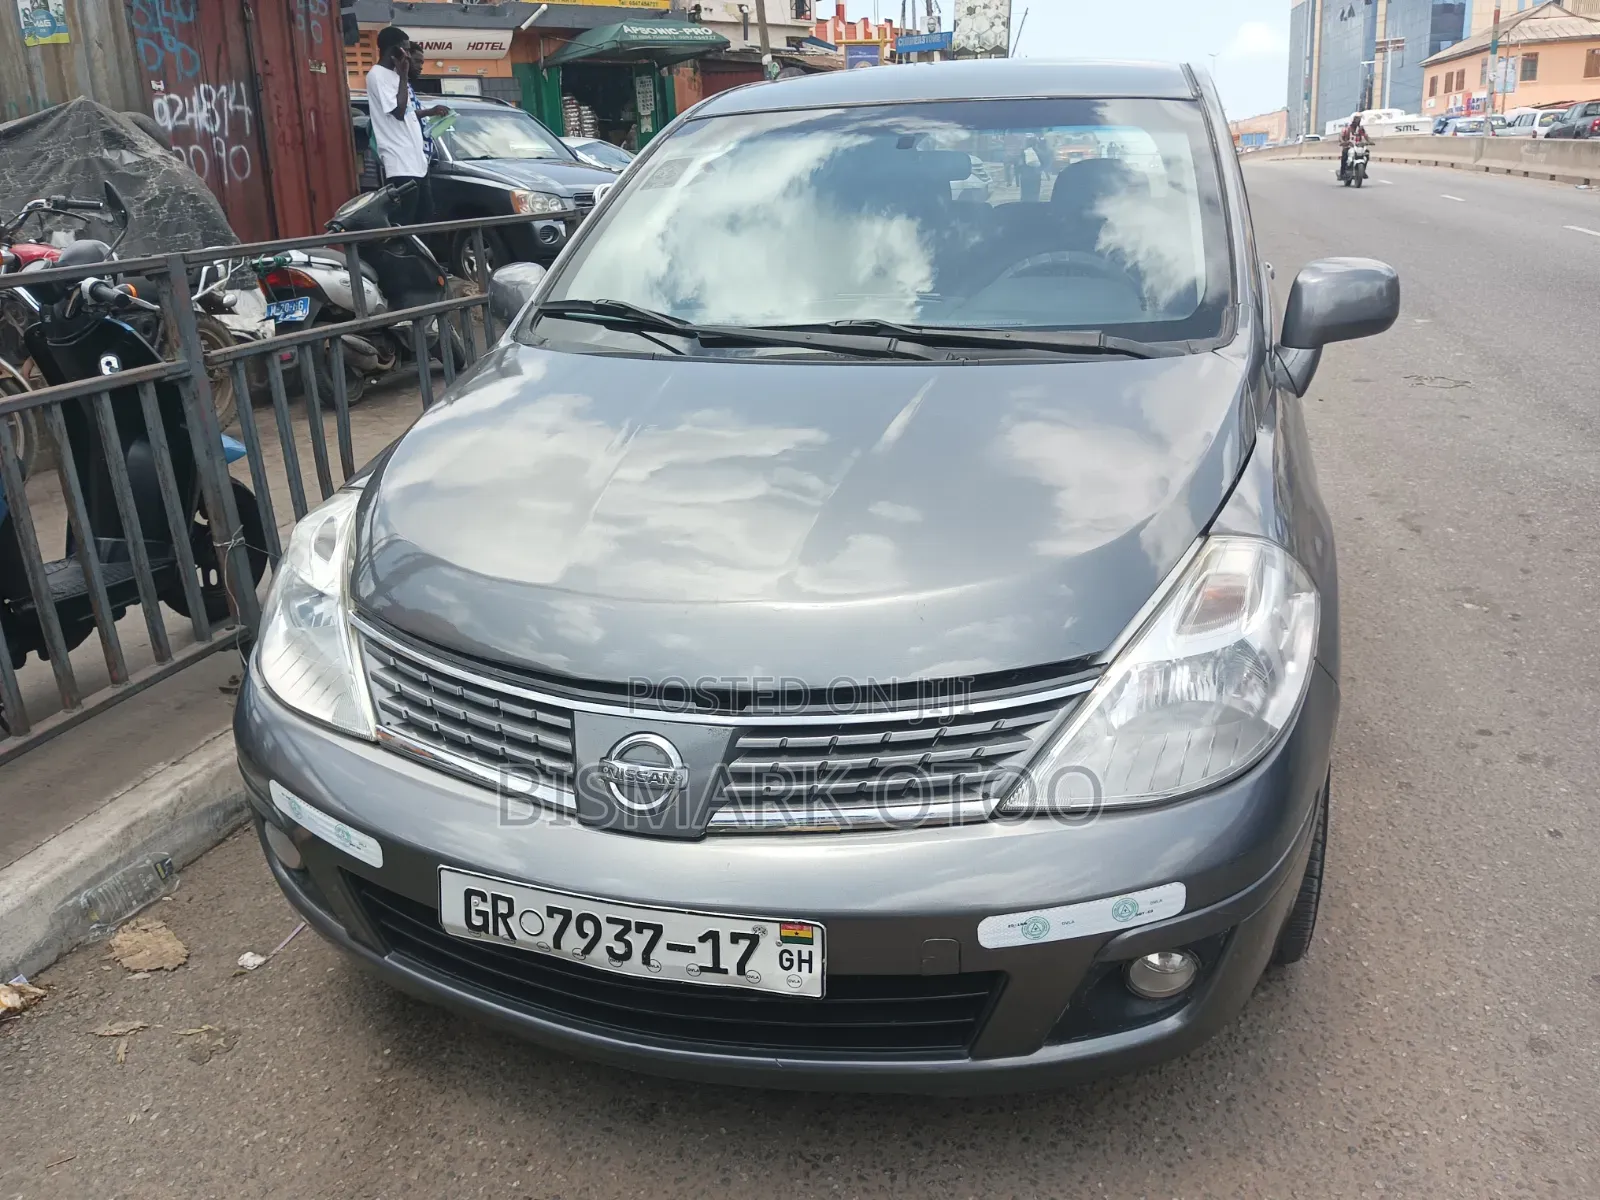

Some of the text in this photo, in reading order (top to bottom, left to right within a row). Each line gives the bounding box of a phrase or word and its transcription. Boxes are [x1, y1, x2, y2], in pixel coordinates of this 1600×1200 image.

[622, 25, 713, 35] APSONIC-PRO
[466, 42, 506, 51] HOTEL
[1395, 124, 1420, 133] SML
[607, 766, 678, 785] NISSAN
[464, 887, 760, 976] GR 7937-17
[778, 948, 813, 974] GH
